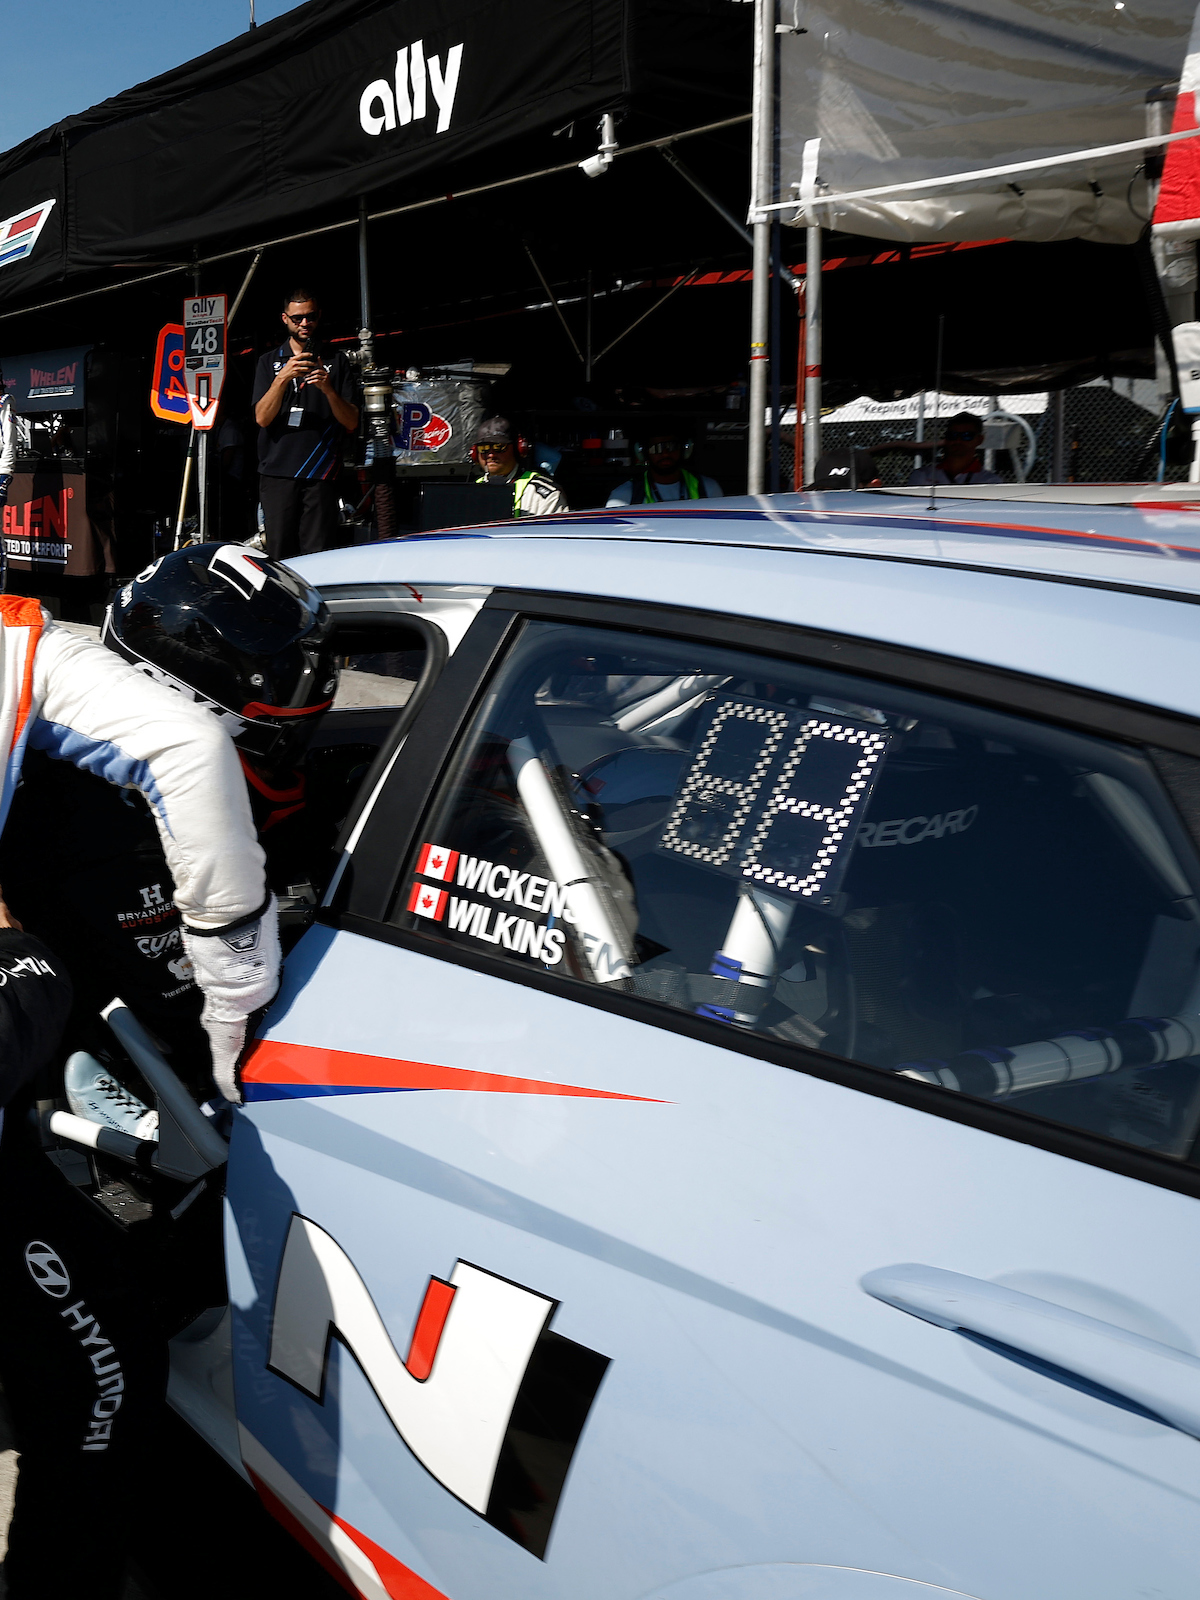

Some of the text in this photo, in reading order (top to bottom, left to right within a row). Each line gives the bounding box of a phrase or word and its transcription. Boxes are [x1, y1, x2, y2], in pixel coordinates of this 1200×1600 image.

[359, 39, 464, 136] ally
[192, 298, 216, 316] ally
[191, 327, 218, 353] 48
[30, 361, 77, 387] WHELEN
[410, 426, 452, 444] Racing
[2, 488, 69, 539] ELEN
[21, 540, 31, 555] TO
[857, 803, 980, 848] RECARO
[117, 909, 157, 922] BRYAN
[137, 930, 181, 955] CUR
[447, 896, 567, 966] WILKINS
[60, 1300, 126, 1451] HYUNDAI
